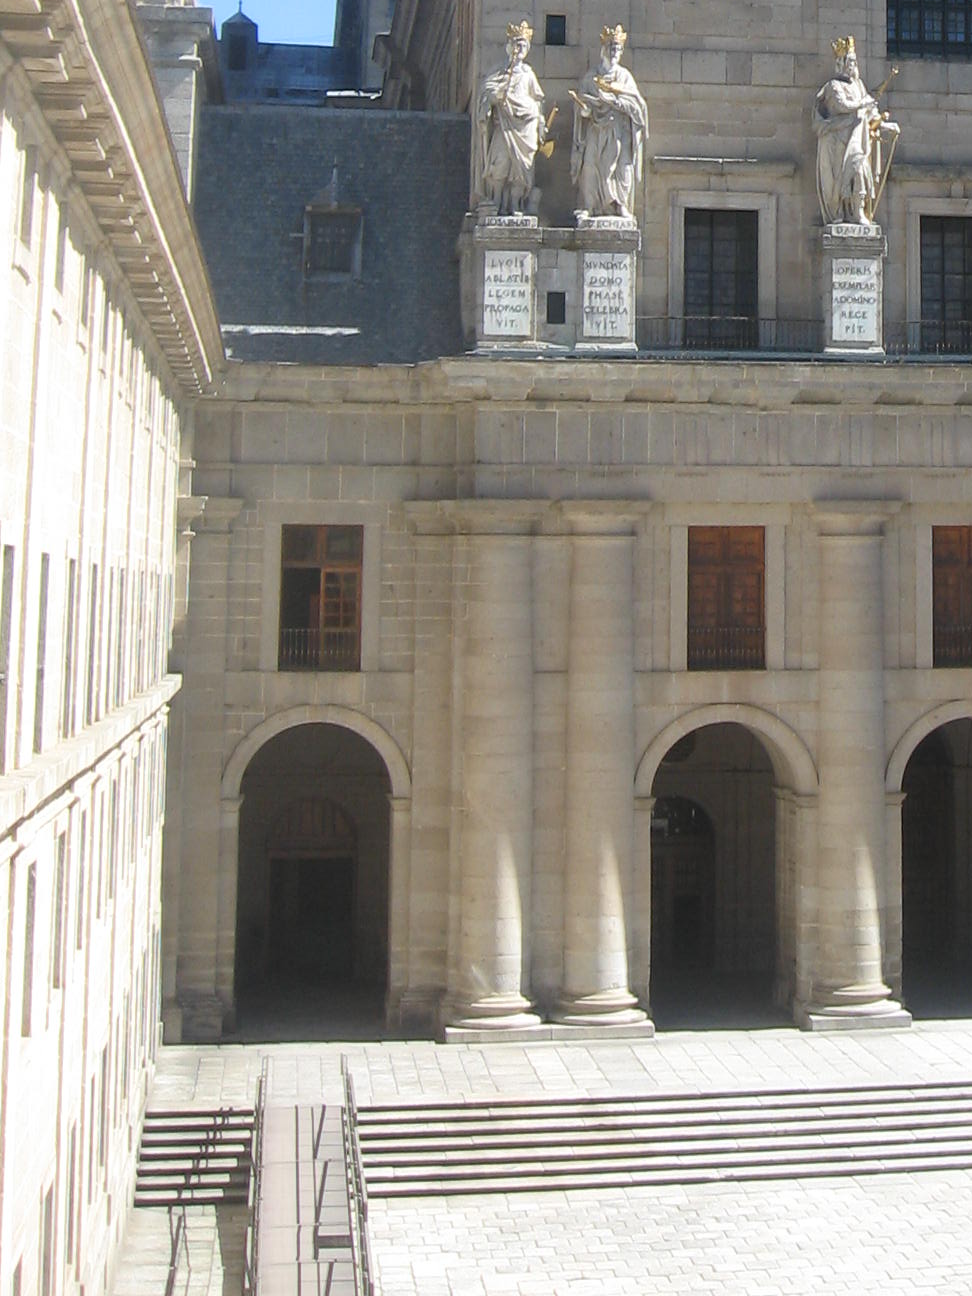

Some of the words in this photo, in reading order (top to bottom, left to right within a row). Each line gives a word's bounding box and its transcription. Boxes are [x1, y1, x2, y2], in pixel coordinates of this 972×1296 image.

[836, 226, 871, 235] DAVID
[589, 275, 623, 285] DOMO
[488, 289, 526, 299] LEGEM
[485, 304, 529, 313] PROPAGA
[584, 305, 628, 315] CELEBRA
[841, 310, 868, 319] RECE
